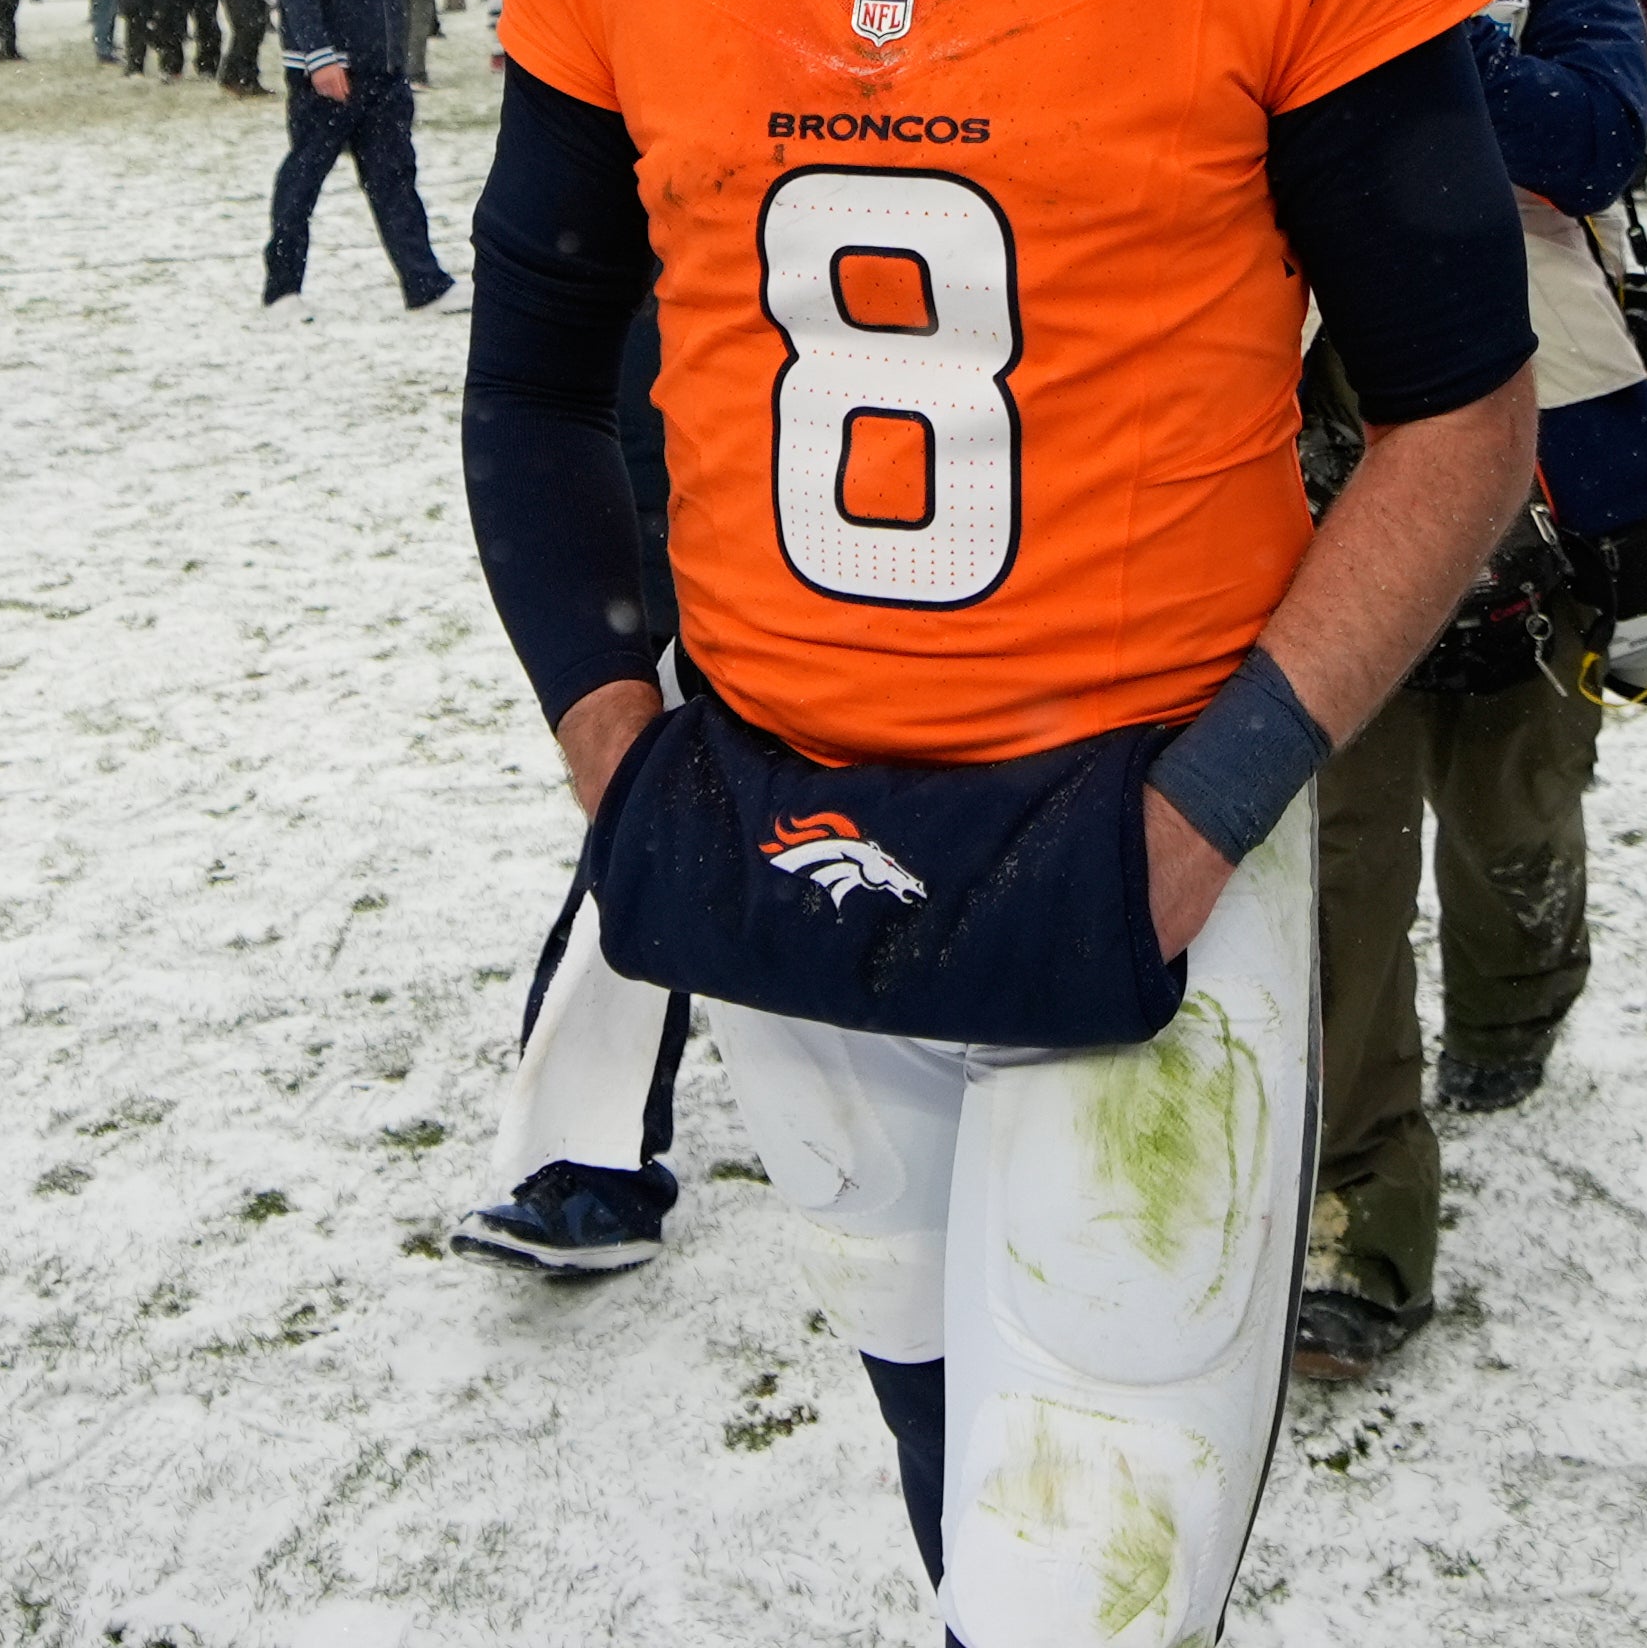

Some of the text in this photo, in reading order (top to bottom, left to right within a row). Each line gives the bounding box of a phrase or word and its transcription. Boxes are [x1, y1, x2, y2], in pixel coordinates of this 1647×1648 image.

[863, 3, 901, 32] NFL
[768, 113, 990, 144] BRONCOS
[756, 164, 1023, 611] 8
